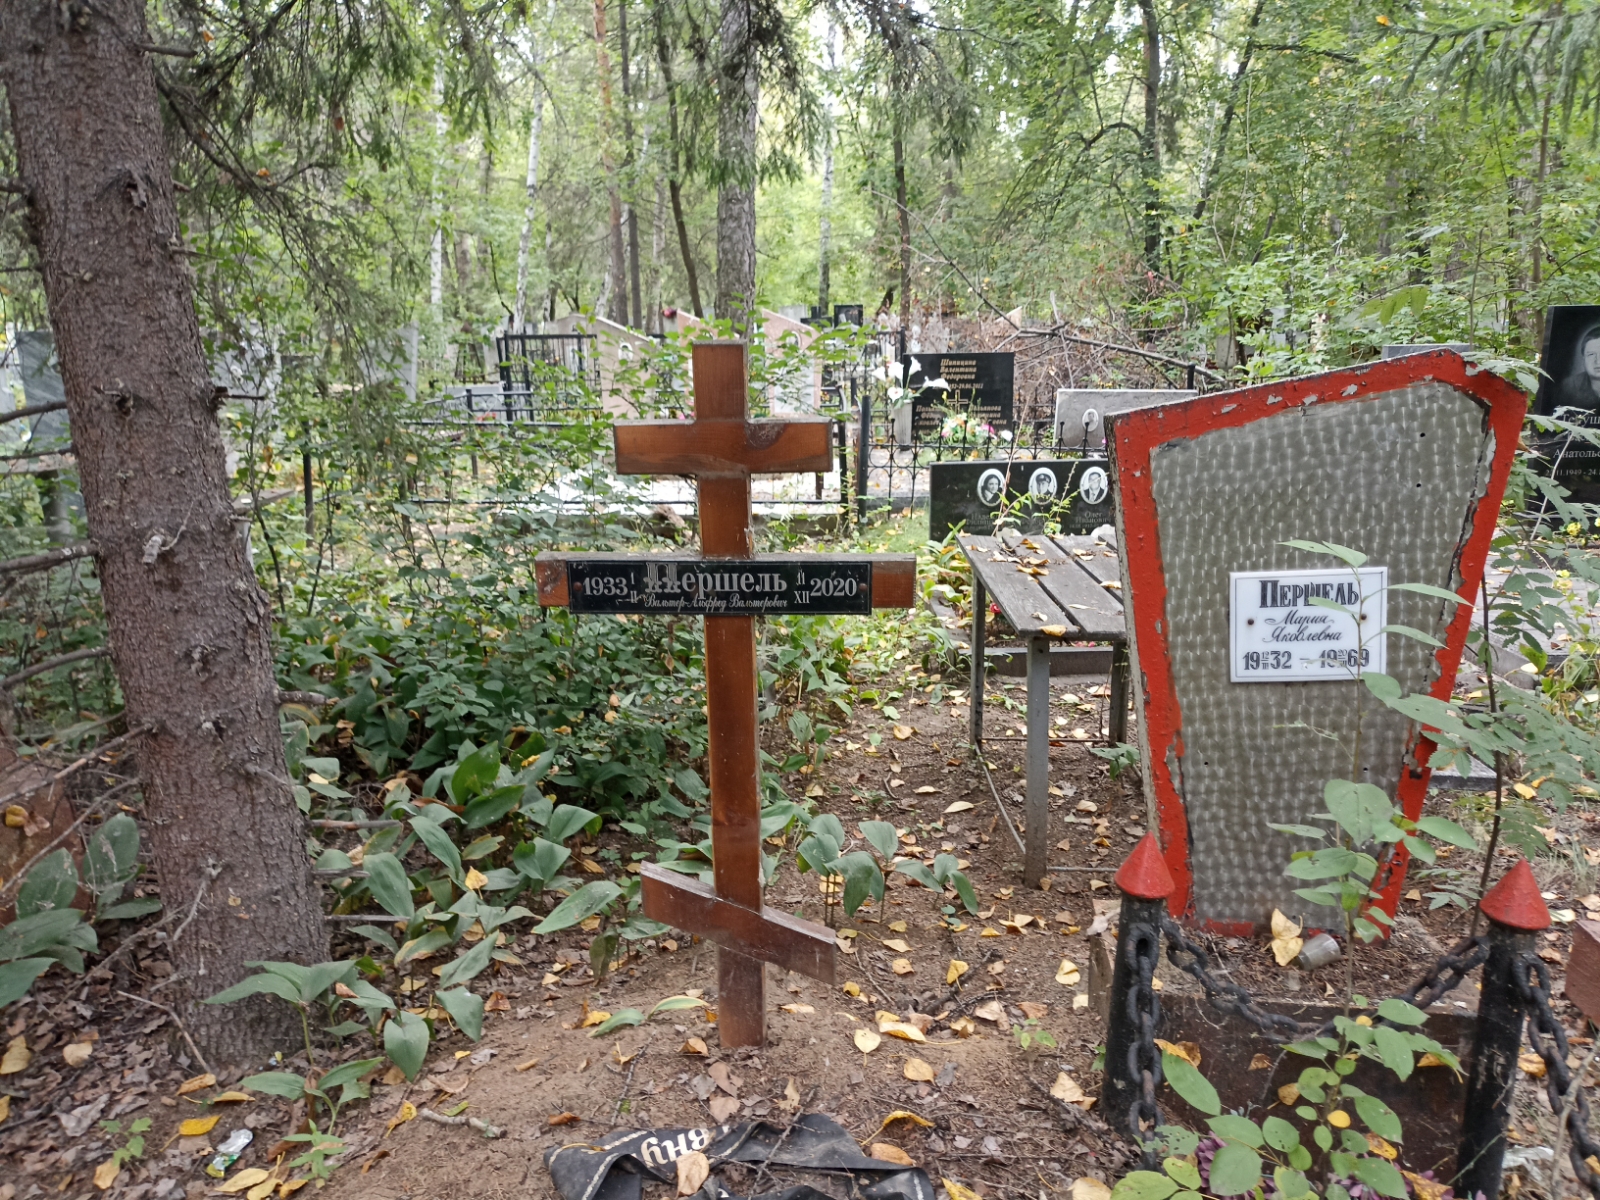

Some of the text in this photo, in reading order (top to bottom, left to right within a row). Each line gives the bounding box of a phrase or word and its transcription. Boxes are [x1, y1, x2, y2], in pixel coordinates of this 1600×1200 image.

[583, 562, 857, 600] 1933 Першель 2020
[1264, 609, 1335, 633] Мария
[1262, 625, 1343, 643] Яковлевна
